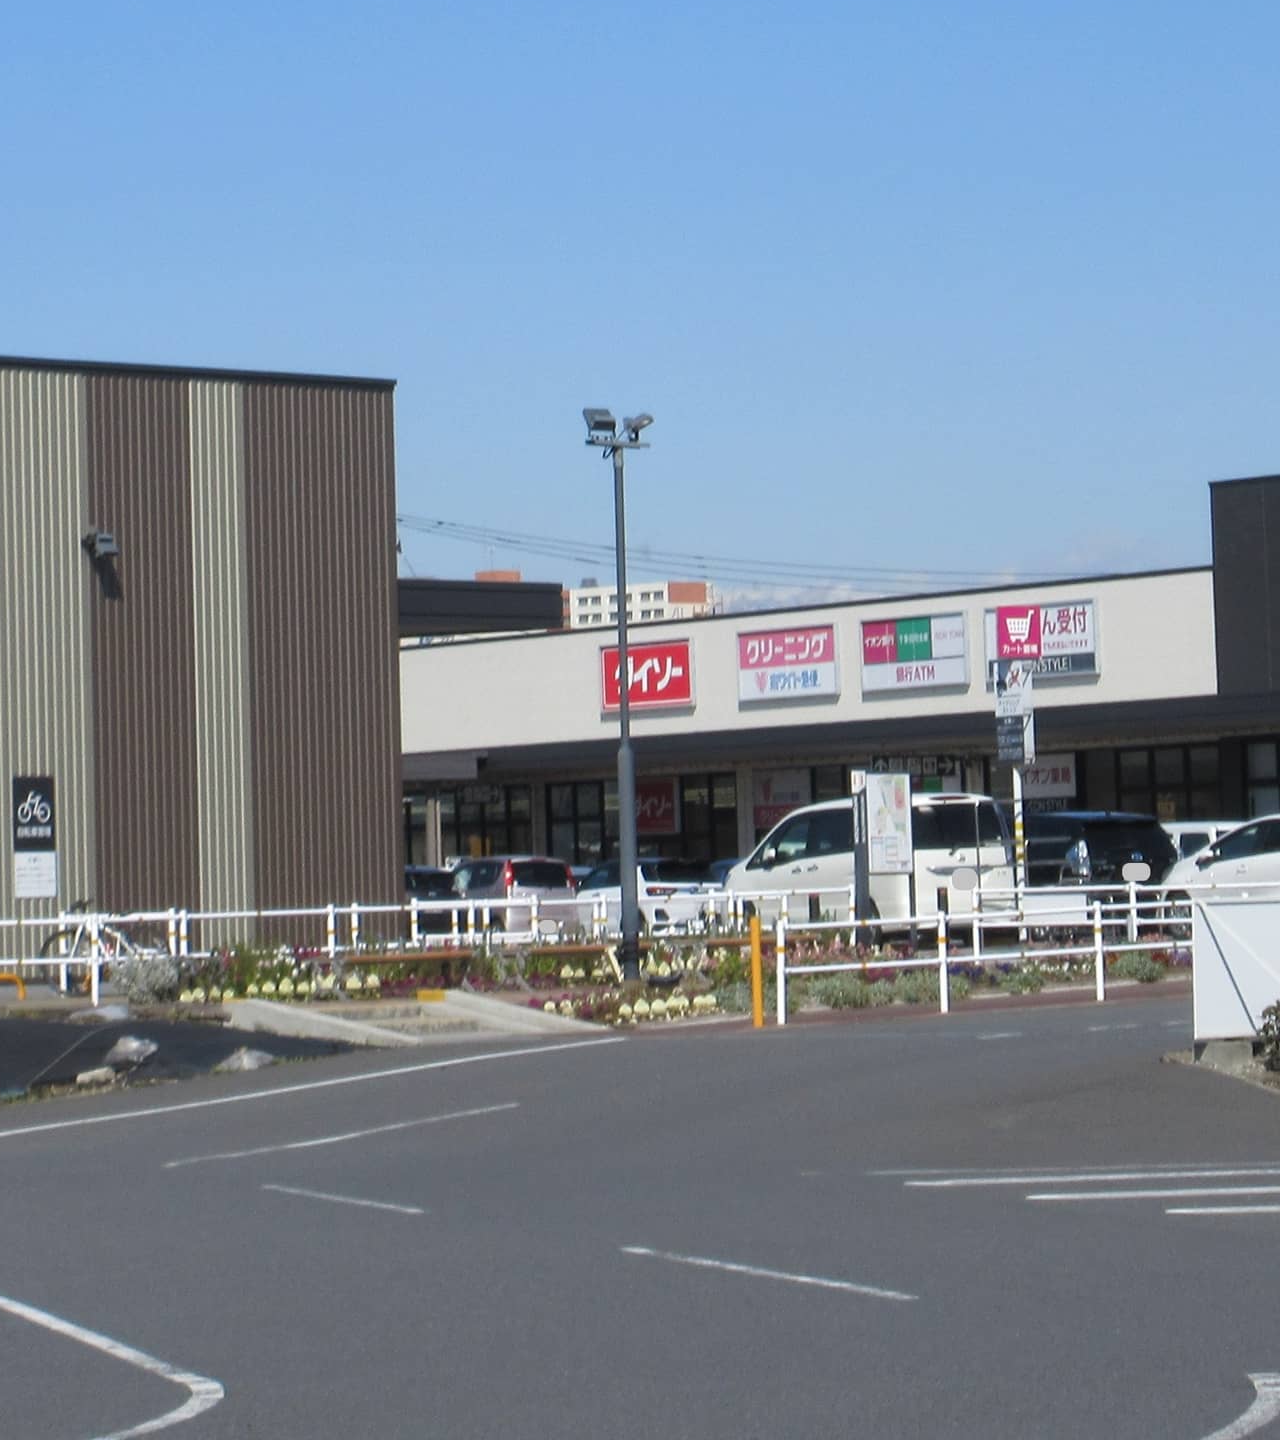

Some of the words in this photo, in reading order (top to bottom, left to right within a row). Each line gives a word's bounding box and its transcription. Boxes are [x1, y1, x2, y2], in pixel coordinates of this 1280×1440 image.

[1042, 606, 1087, 636] ん受付
[746, 632, 828, 665] クリーニング
[1041, 656, 1069, 672] STYLE
